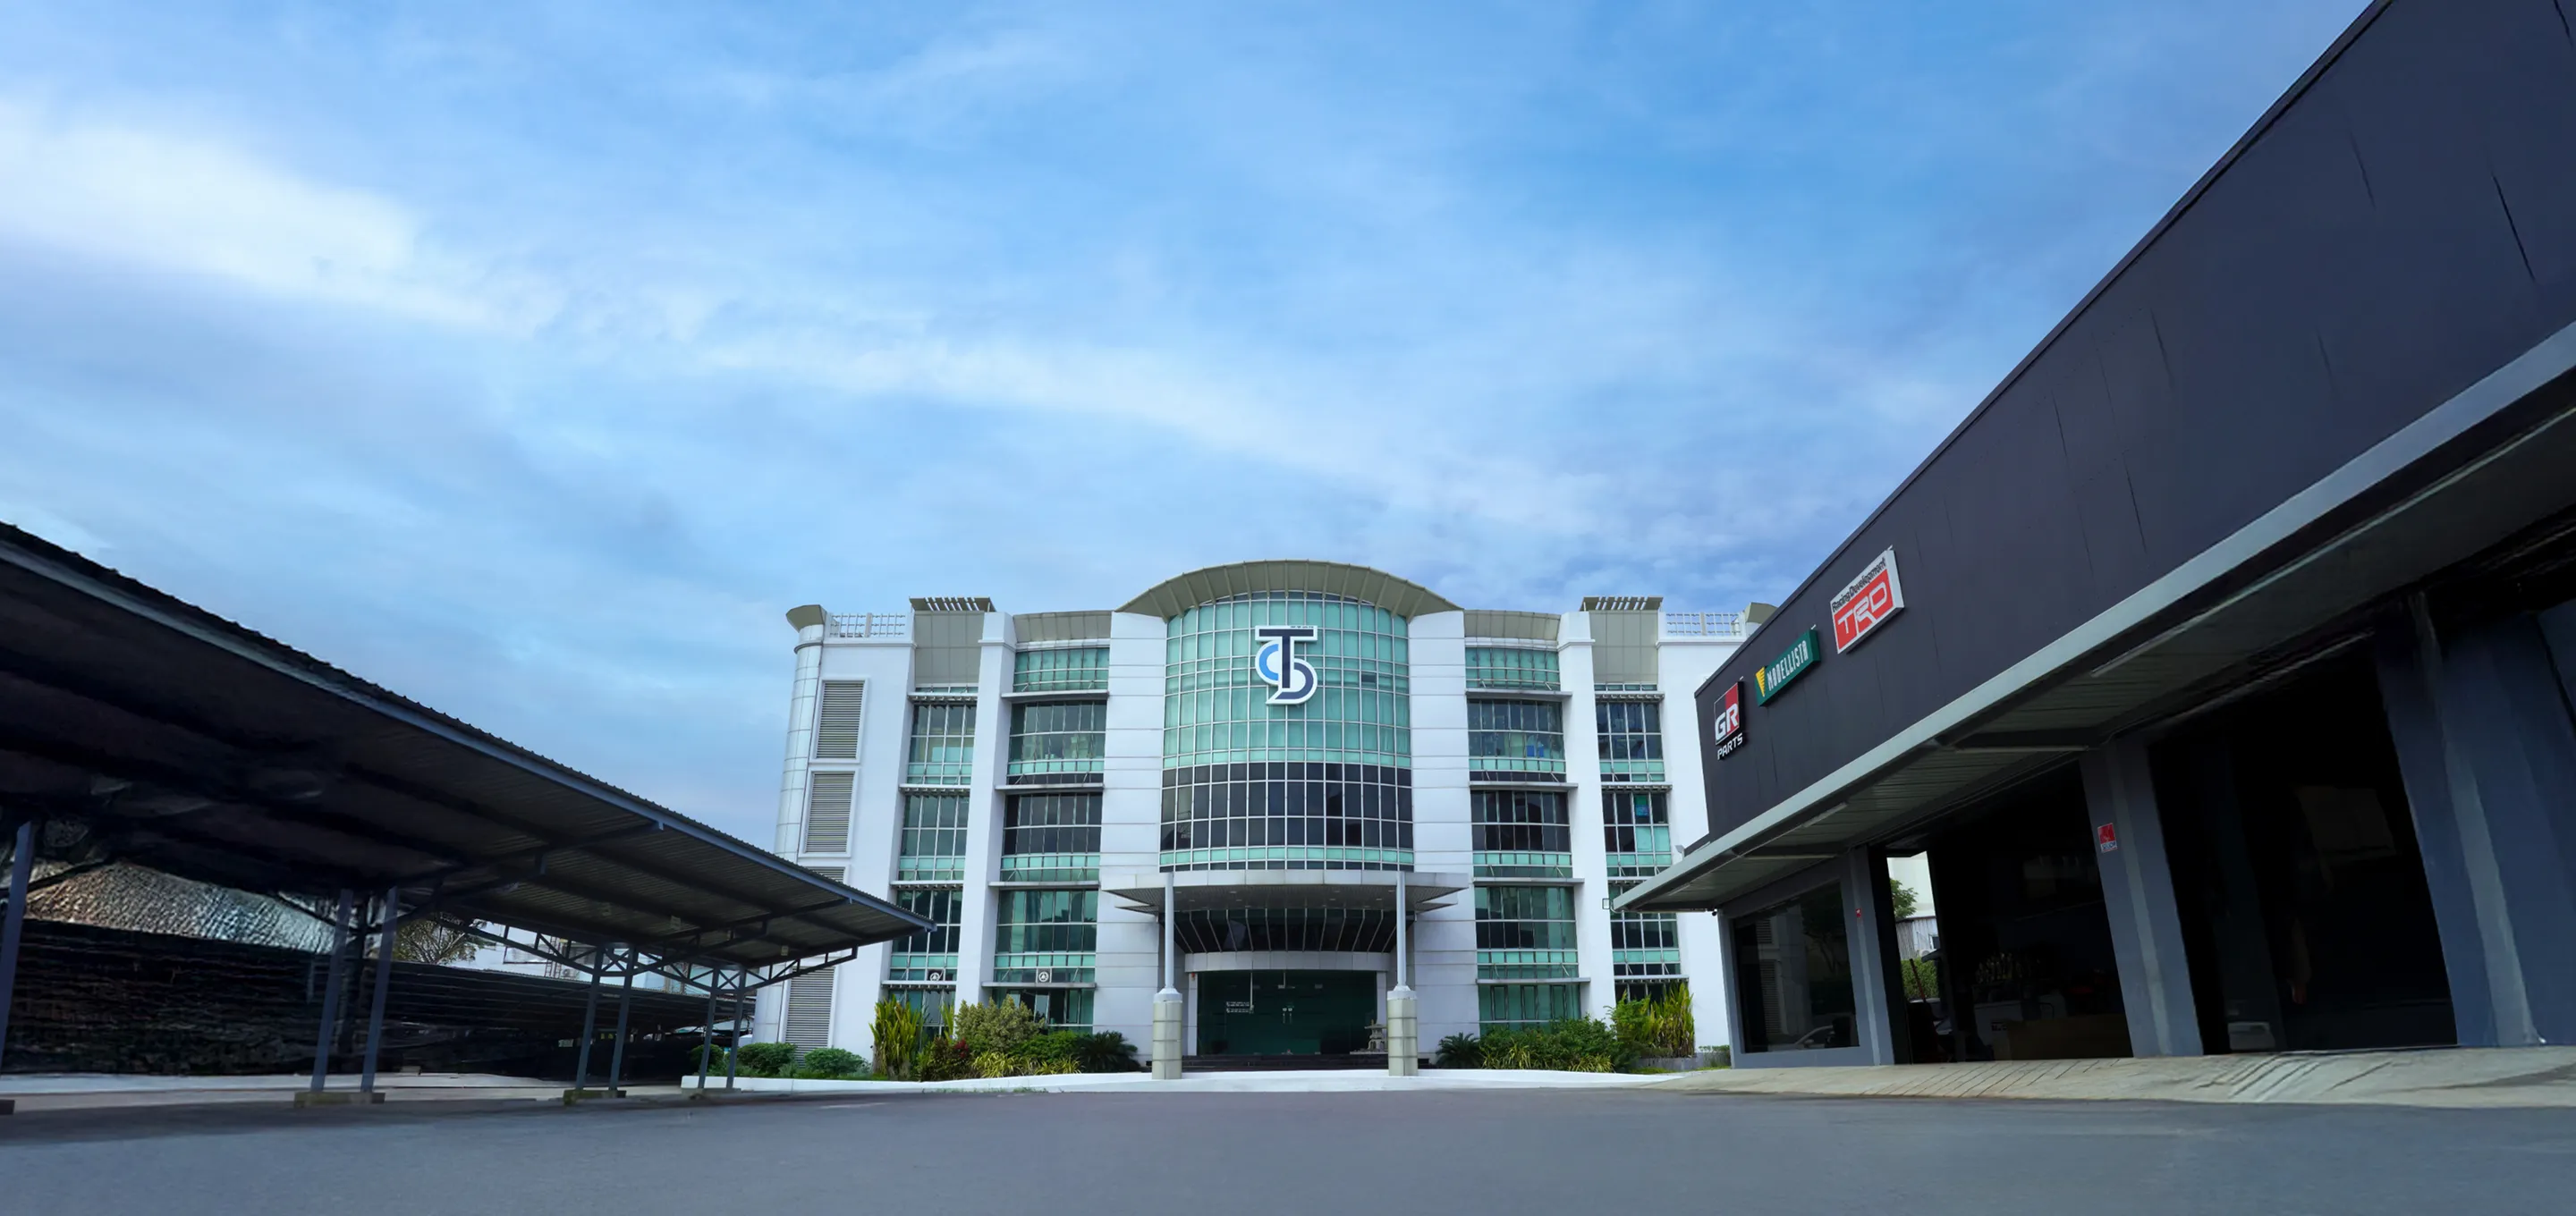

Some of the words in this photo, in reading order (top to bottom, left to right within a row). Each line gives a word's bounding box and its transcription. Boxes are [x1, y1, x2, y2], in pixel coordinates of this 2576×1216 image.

[1831, 593, 1851, 612] Racing
[1849, 556, 1886, 596] Development
[1837, 581, 1887, 636] TRD
[1767, 639, 1809, 691] MODELLISTA
[1715, 703, 1739, 740] GR
[1716, 732, 1743, 760] PARTS
